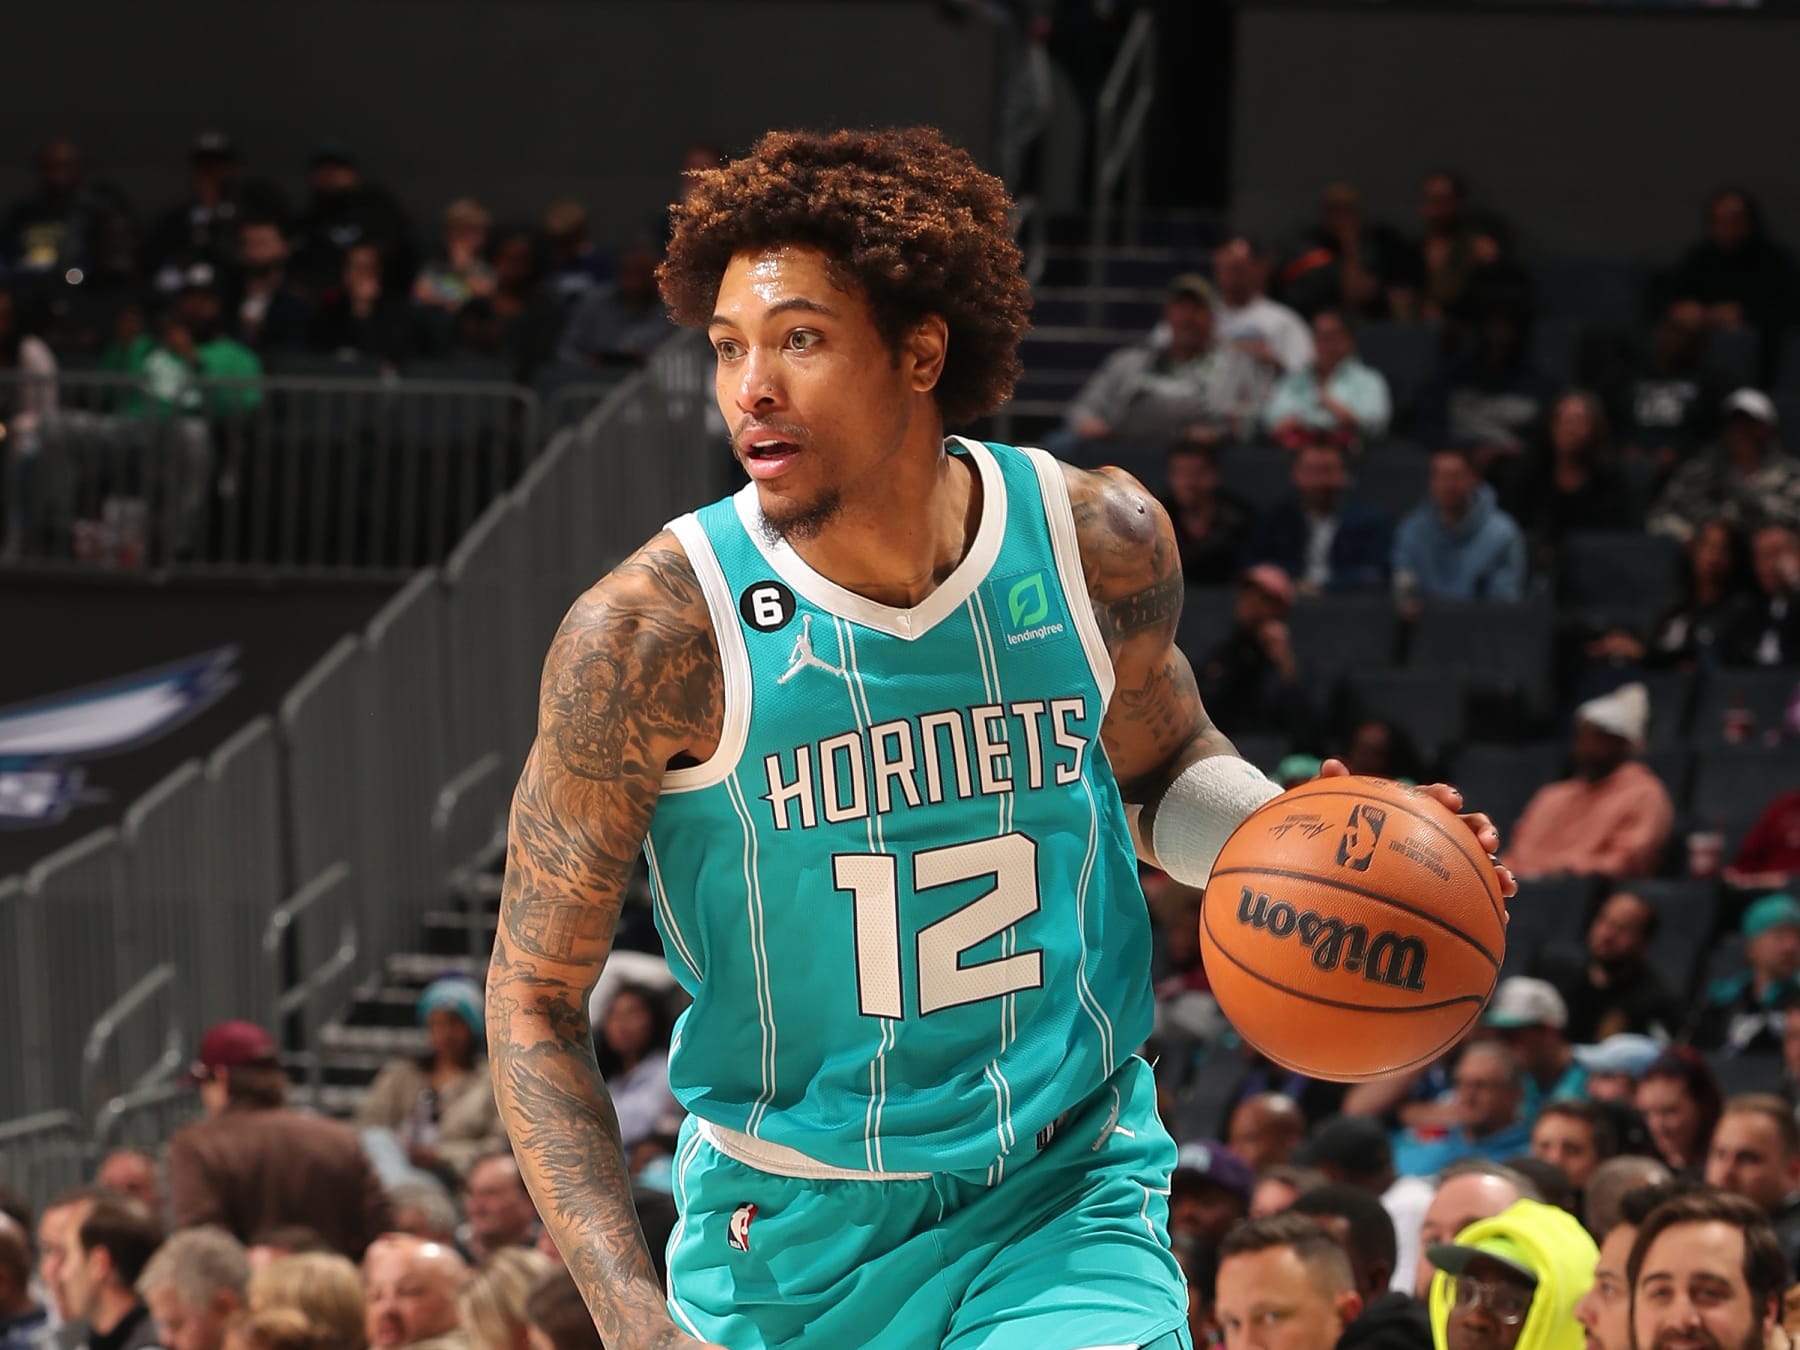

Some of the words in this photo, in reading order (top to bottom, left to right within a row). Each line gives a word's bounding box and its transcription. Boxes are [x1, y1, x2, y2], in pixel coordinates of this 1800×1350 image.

[751, 587, 784, 628] 6
[1007, 623, 1064, 646] lendingtree
[758, 696, 1090, 831] HORNETS
[831, 830, 1044, 1021] 12
[1236, 886, 1428, 993] Wilson
